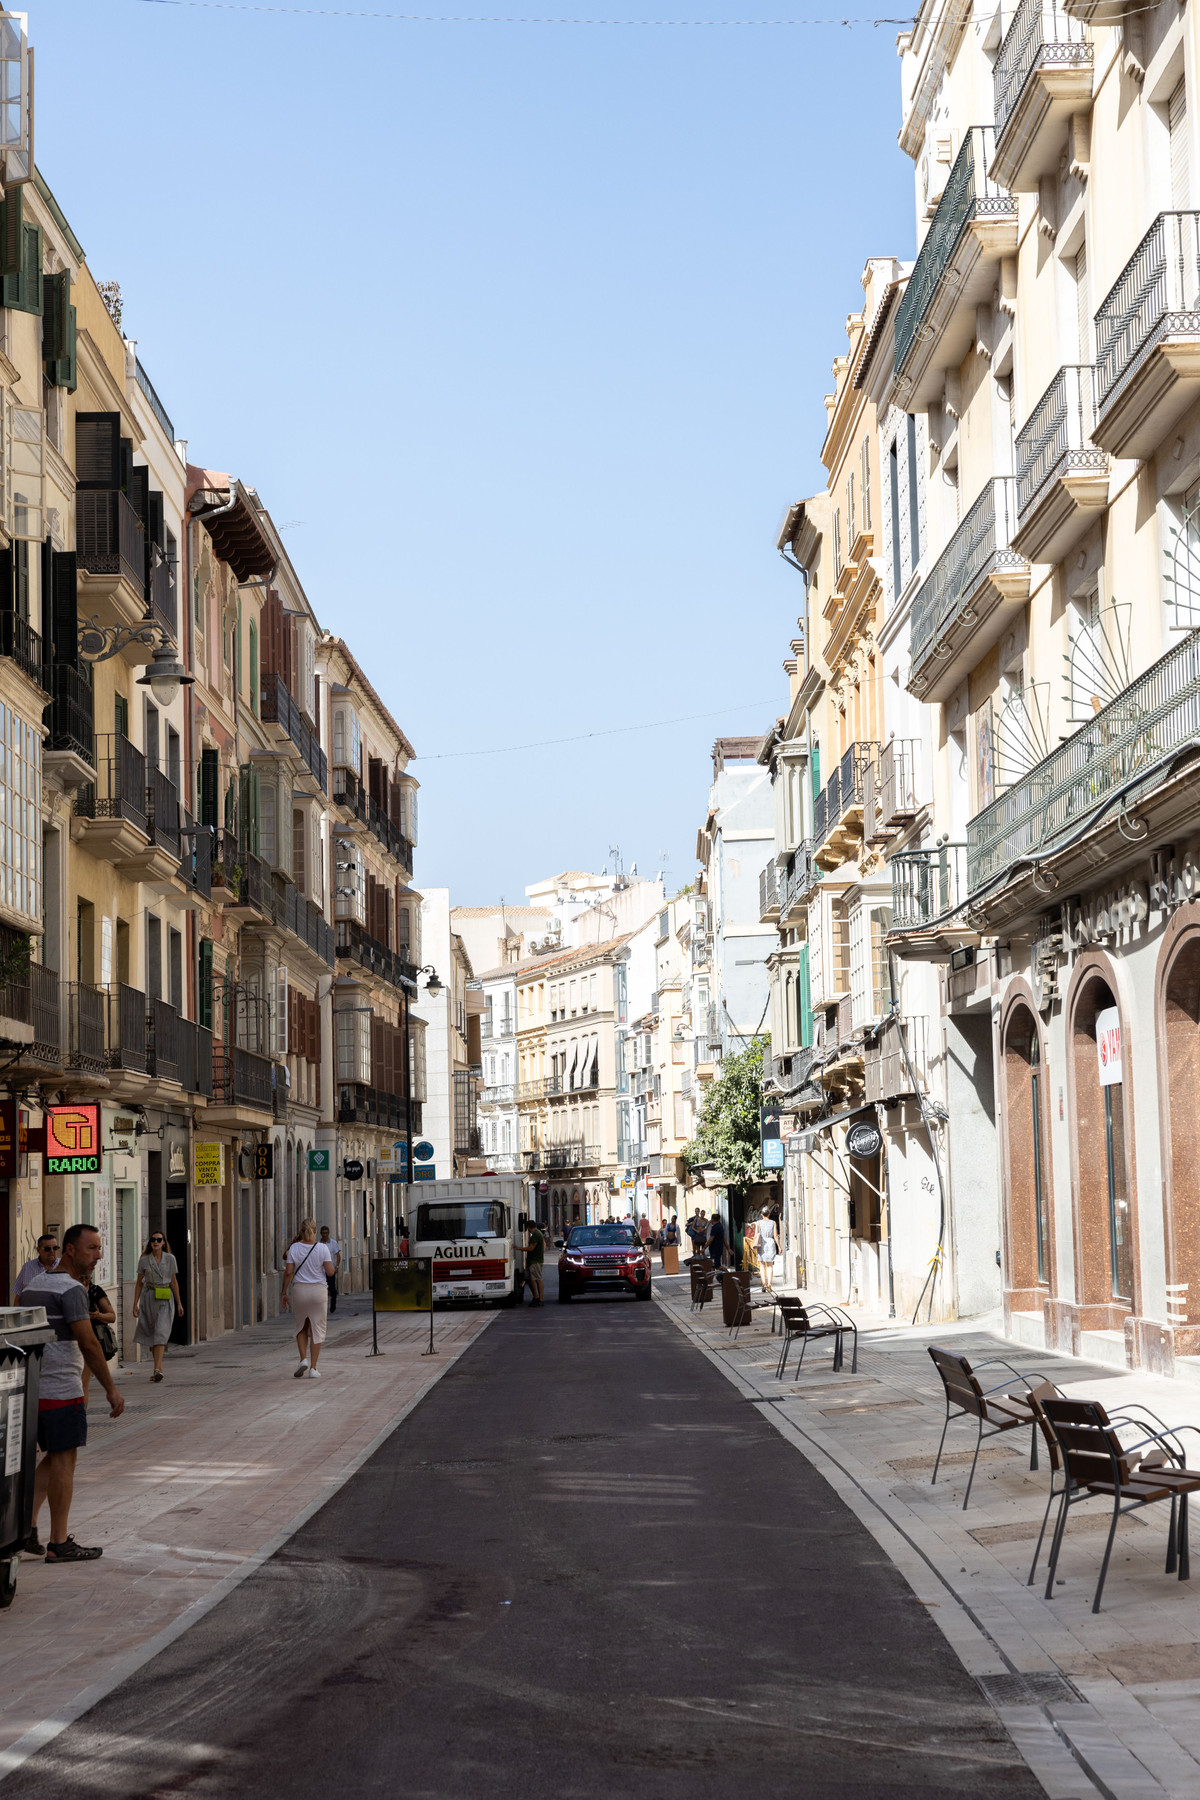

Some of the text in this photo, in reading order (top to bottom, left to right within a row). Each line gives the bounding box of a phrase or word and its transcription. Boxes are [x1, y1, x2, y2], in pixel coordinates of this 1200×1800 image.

[48, 1157, 97, 1173] RARIO
[258, 1147, 268, 1177] ORO
[415, 1170, 434, 1179] ORO
[433, 1246, 486, 1258] AGUILA
